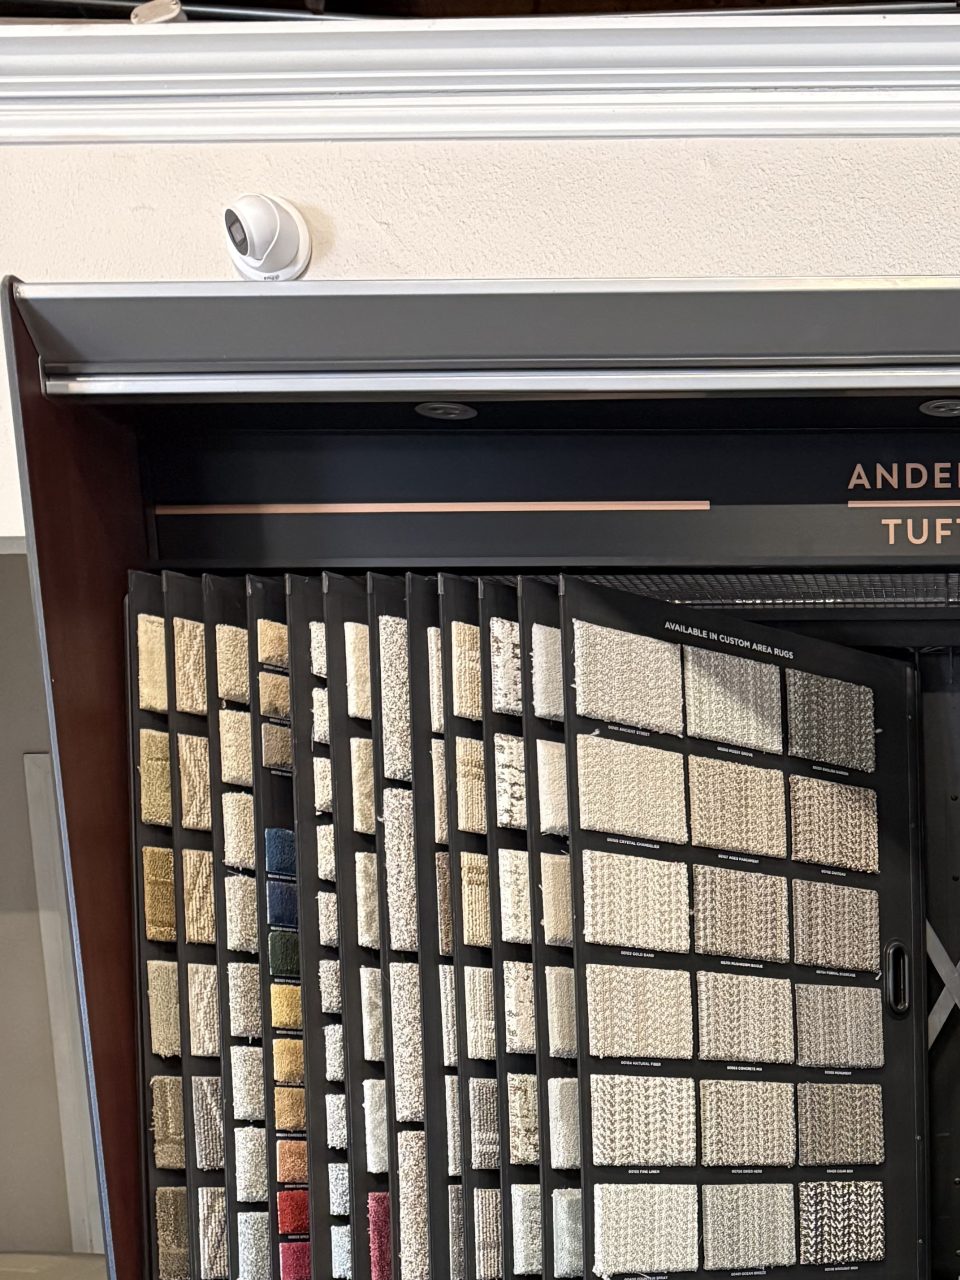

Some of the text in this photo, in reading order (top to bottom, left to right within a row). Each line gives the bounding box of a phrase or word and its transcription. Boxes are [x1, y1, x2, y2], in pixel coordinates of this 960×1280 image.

[664, 621, 794, 660] AVAILABLE IN CUSTOM AREA RUGS
